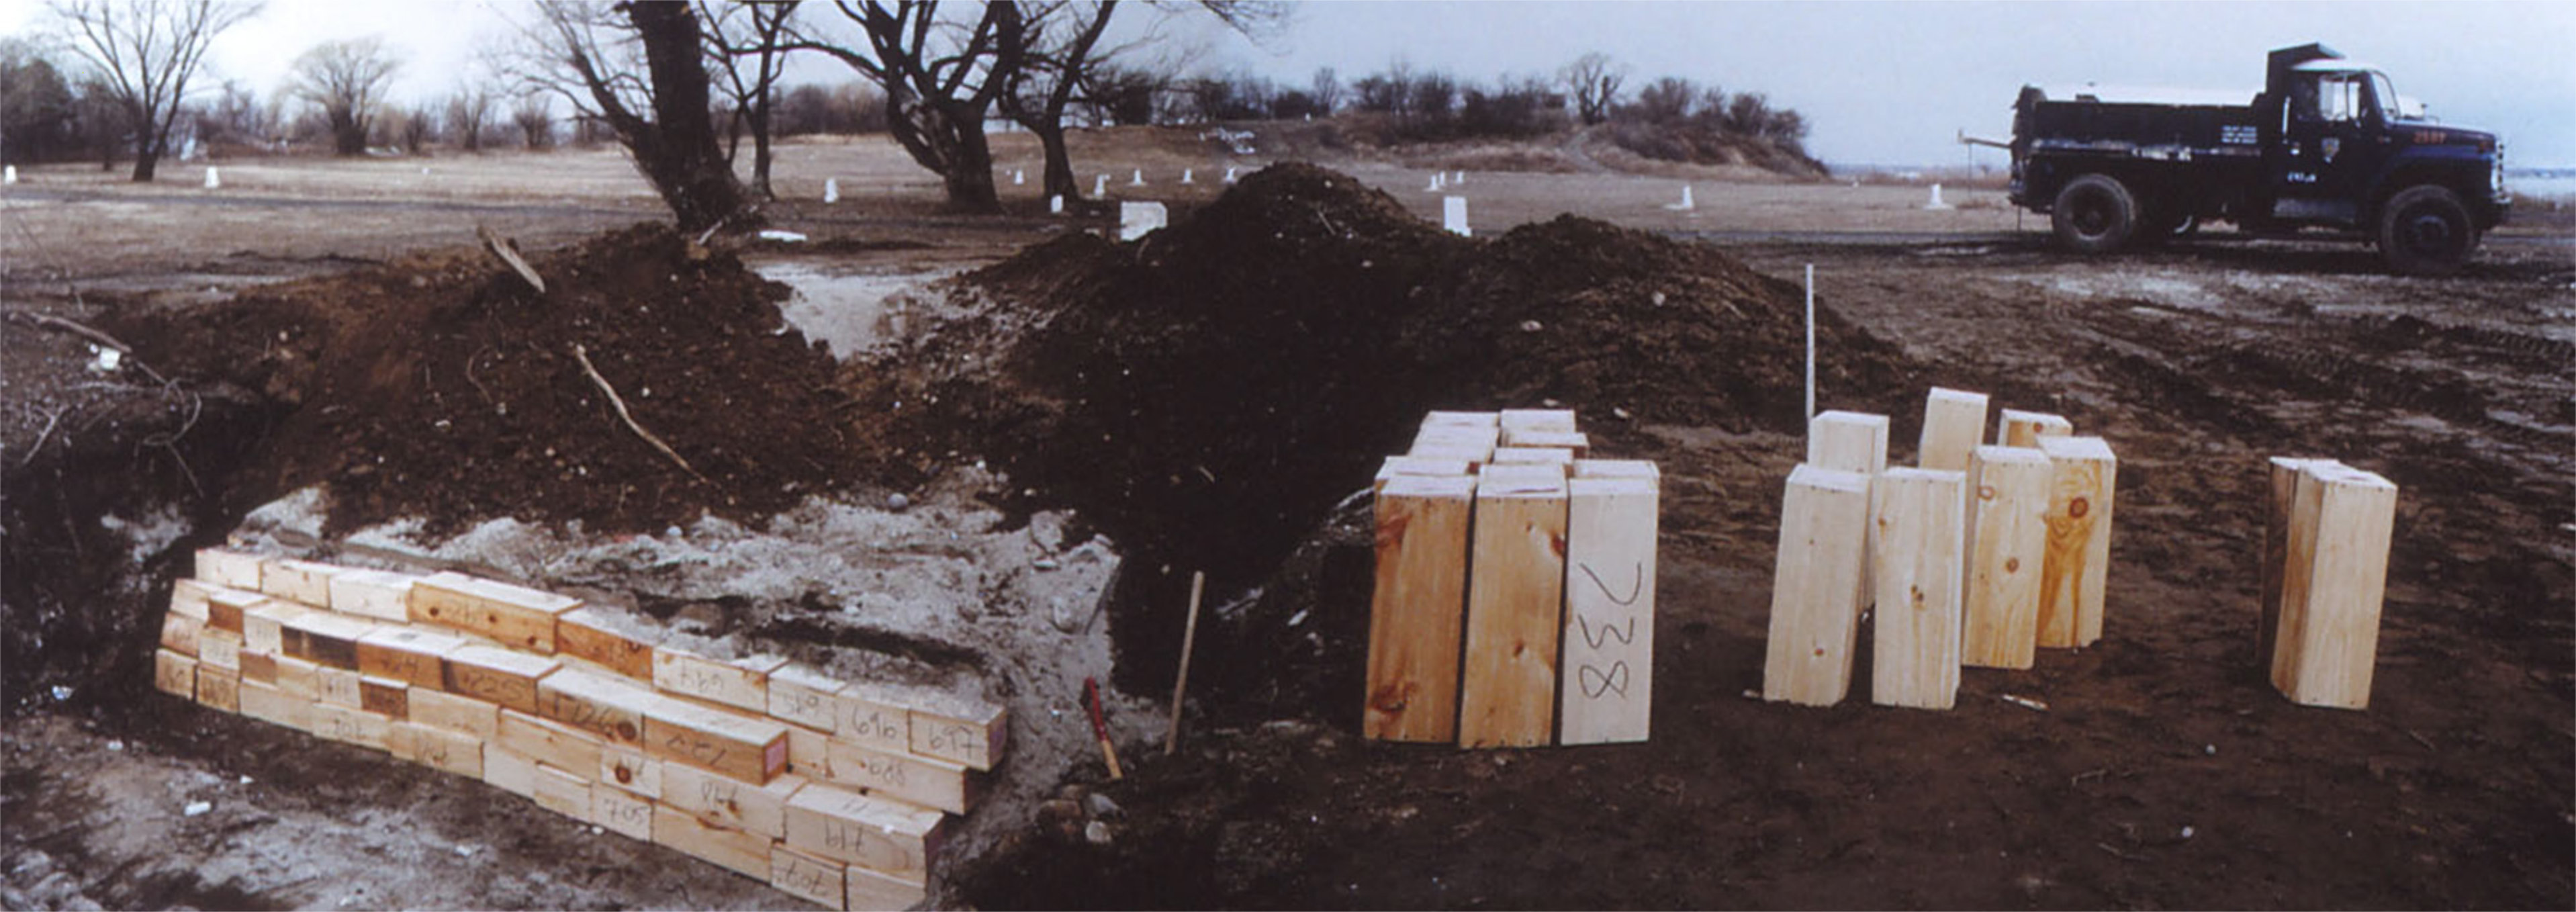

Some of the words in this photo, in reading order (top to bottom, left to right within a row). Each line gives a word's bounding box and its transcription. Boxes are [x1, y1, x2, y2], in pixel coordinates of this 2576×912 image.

[1577, 561, 1643, 700] 738
[852, 706, 897, 739] 696
[928, 723, 984, 759] 697
[604, 797, 649, 825] 705
